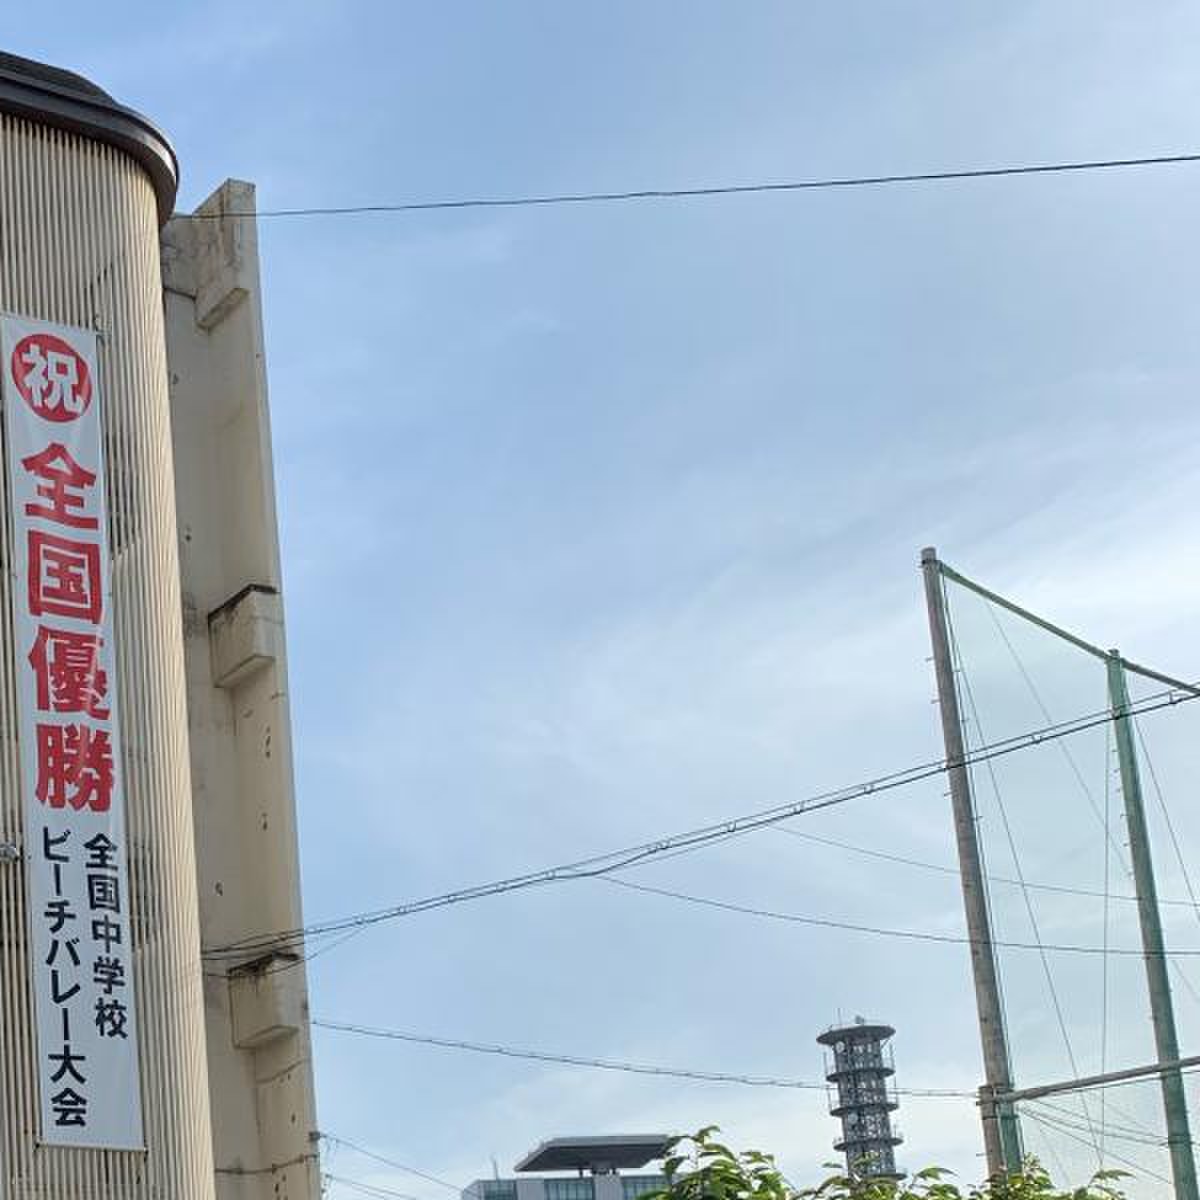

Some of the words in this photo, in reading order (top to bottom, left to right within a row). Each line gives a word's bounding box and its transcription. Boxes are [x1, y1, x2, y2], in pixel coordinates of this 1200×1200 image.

[21, 343, 85, 415] 祝
[21, 442, 115, 812] 全国優勝
[42, 826, 88, 1127] ビーチバレー大会
[83, 833, 128, 1039] 全国中学校
